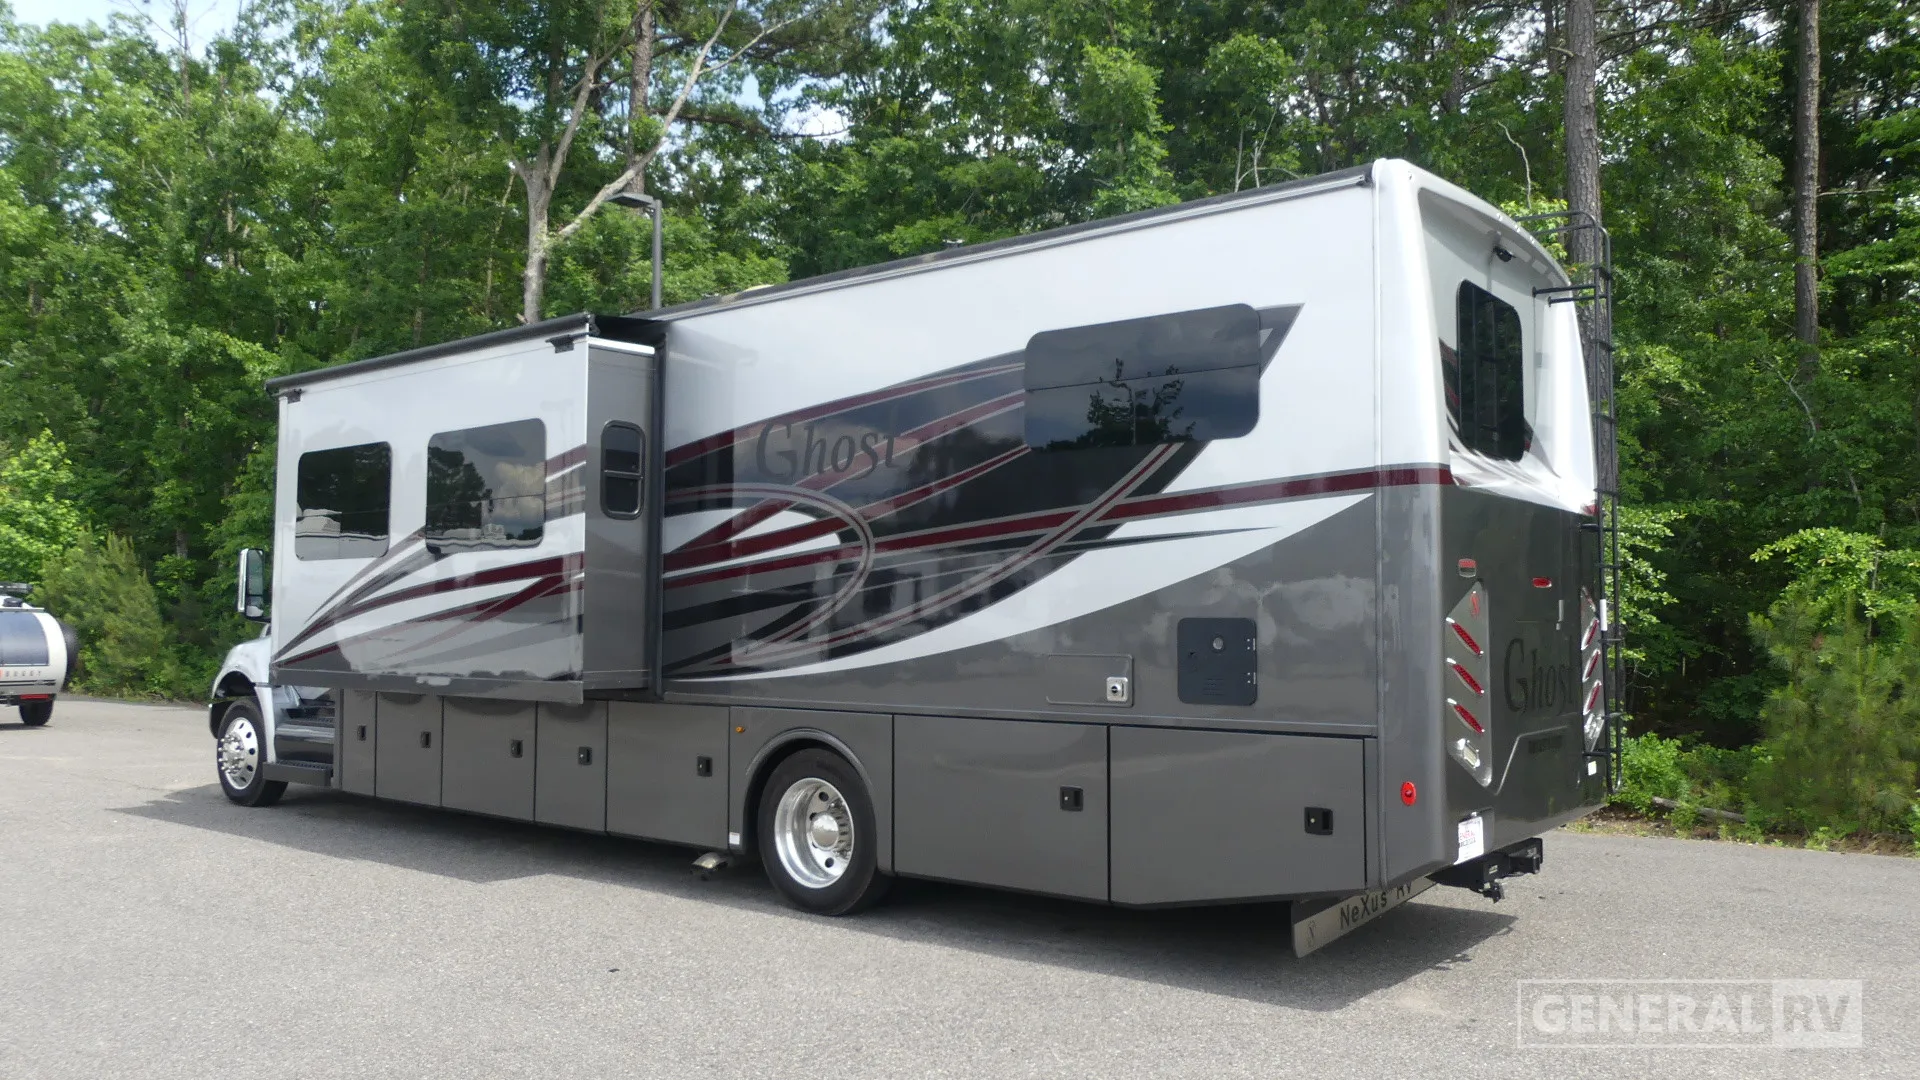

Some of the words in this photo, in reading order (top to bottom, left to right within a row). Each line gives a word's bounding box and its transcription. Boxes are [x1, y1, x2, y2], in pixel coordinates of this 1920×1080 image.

[756, 412, 900, 483] Ghost
[1504, 636, 1574, 716] Ghost
[1339, 890, 1388, 929] NeXus
